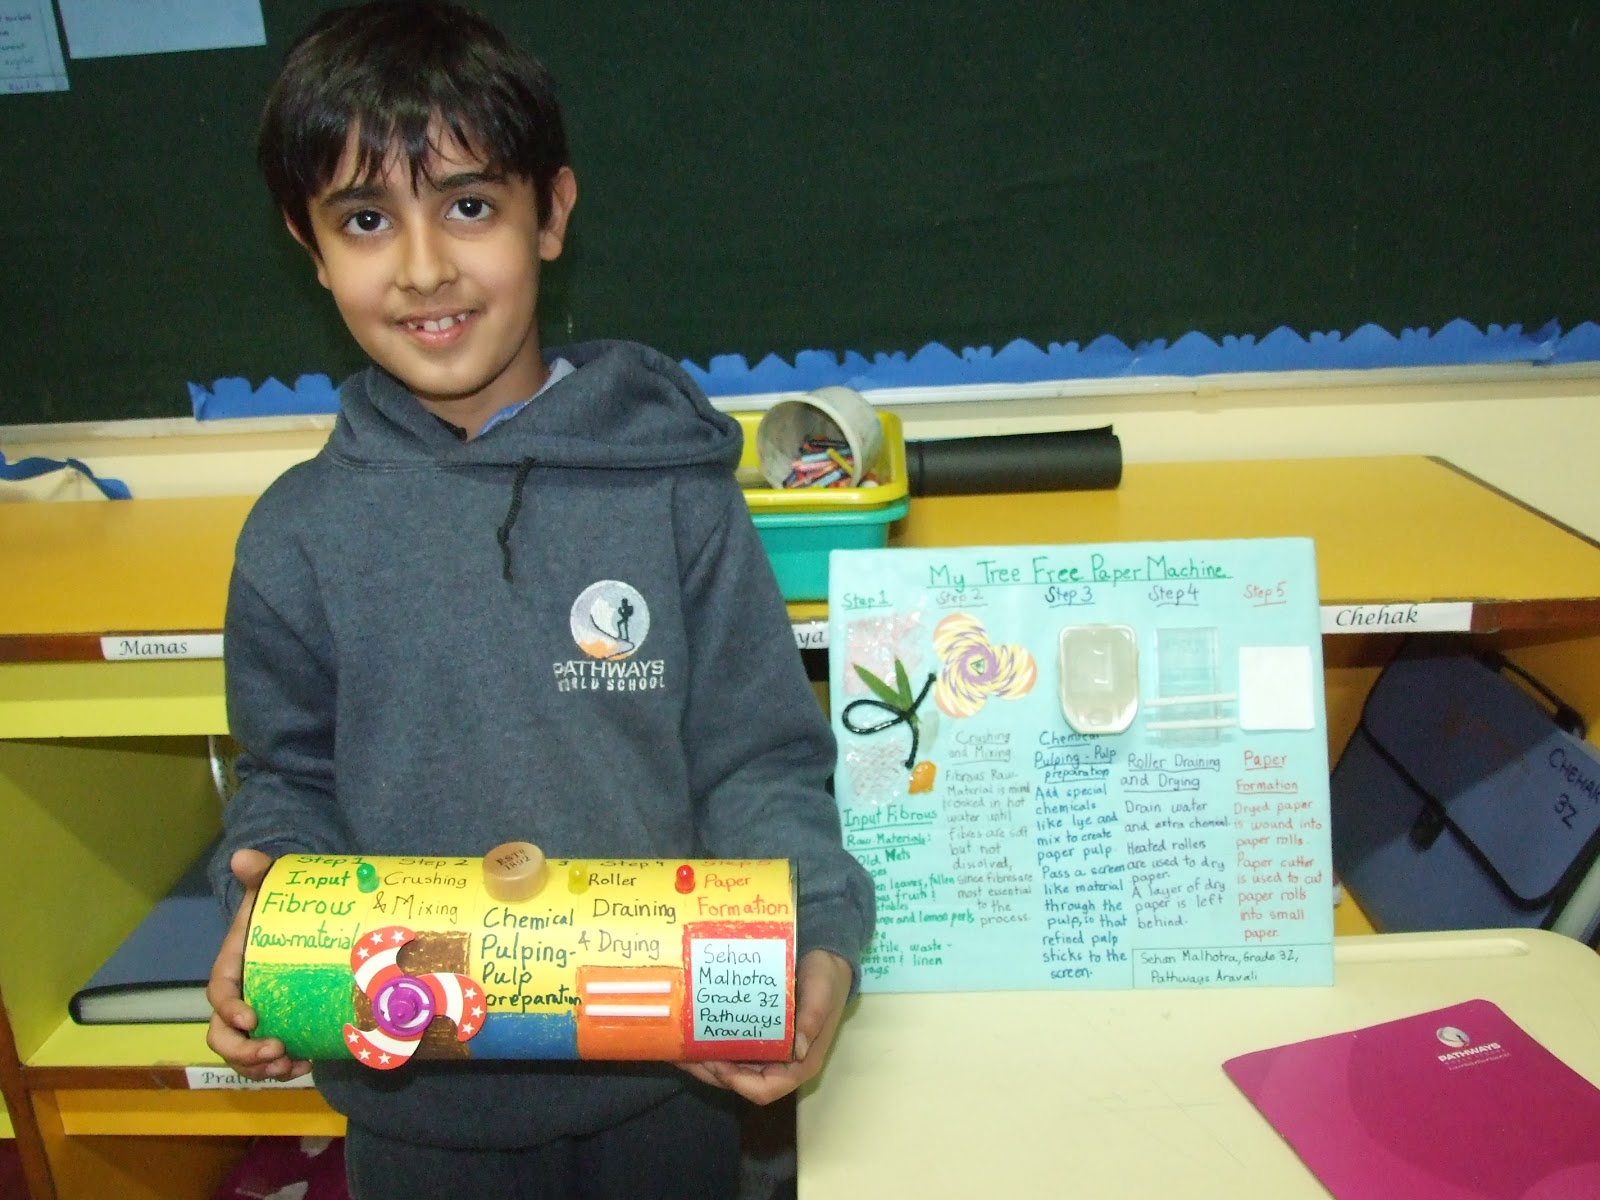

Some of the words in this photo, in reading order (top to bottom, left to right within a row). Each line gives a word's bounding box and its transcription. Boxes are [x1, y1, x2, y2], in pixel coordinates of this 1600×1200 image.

[929, 565, 966, 592] My
[977, 561, 1021, 584] Tree
[1033, 556, 1084, 583] Free
[1091, 554, 1142, 587] Paper
[1147, 555, 1229, 581] Machine
[843, 591, 875, 608] Step
[936, 590, 966, 606] Step
[971, 588, 984, 600] 2
[1045, 586, 1078, 605] Step
[1082, 586, 1093, 602] 3
[1148, 585, 1185, 605] Step
[1187, 583, 1200, 601] 4
[1243, 584, 1273, 604] Step
[1275, 581, 1287, 597] 5
[1336, 604, 1419, 627] Chehak
[119, 640, 188, 656] Manas
[553, 660, 665, 678] PATHWAYS
[606, 676, 665, 692] SCHOOL
[955, 730, 1011, 745] Crushing
[976, 745, 1012, 762] Mixing
[1035, 751, 1080, 770] Pulping
[1094, 745, 1117, 764] Pulp
[1128, 752, 1168, 769] Roller
[1174, 753, 1221, 772] Draining
[1244, 750, 1287, 769] Paper
[1120, 773, 1149, 786] and
[1158, 773, 1201, 792] Drying
[1235, 778, 1298, 791] Formation
[1035, 786, 1059, 801] Add
[1066, 783, 1108, 800] special
[1125, 800, 1162, 814] Drain
[1170, 797, 1208, 814] water
[1277, 800, 1313, 815] paper
[843, 807, 883, 831] Input
[886, 804, 938, 824] Fibrous
[946, 810, 980, 822] water
[1036, 817, 1063, 831] like
[1072, 814, 1093, 830] lye
[1097, 811, 1119, 825] and
[1124, 820, 1150, 833] and
[1154, 817, 1186, 829] extra
[1299, 817, 1323, 831] into
[846, 834, 872, 847] Raw
[1037, 834, 1061, 846] mix
[1066, 830, 1078, 843] to
[1081, 828, 1113, 842] create
[1236, 836, 1270, 851] paper
[949, 841, 972, 856] but
[980, 841, 1002, 855] not
[1037, 848, 1075, 867] paper
[1083, 844, 1112, 860] pulp
[1126, 838, 1167, 856] Heated
[297, 856, 348, 868] Step
[398, 857, 447, 868] Step
[453, 859, 470, 867] 2
[600, 860, 649, 870] Step
[857, 853, 882, 867] Old
[1126, 860, 1147, 871] are
[1151, 856, 1179, 869] used
[1184, 854, 1196, 868] to
[1200, 855, 1226, 873] dry
[1237, 850, 1273, 872] Paper
[1280, 855, 1315, 868] cutter
[286, 870, 351, 889] Input
[384, 871, 468, 889] Crushing
[588, 873, 638, 887] Roller
[1042, 866, 1071, 879] Pass
[1074, 868, 1087, 877] a
[1090, 864, 1126, 876] screen
[1252, 871, 1282, 884] used
[1287, 871, 1299, 884] to
[1304, 869, 1323, 885] cut
[704, 873, 752, 893] Paper
[1044, 882, 1070, 895] like
[1075, 878, 1124, 893] material
[1131, 886, 1143, 899] A
[1147, 884, 1183, 899] layer
[1186, 876, 1201, 893] of
[1204, 878, 1226, 893] dry
[957, 886, 982, 899] most
[1238, 891, 1274, 906] paper
[262, 891, 357, 916] Fibrous
[372, 890, 387, 914] &
[391, 894, 459, 925] Mixing
[592, 898, 677, 924] Draining
[697, 894, 789, 917] Formation
[991, 899, 1012, 913] the
[1045, 898, 1096, 914] through
[1102, 899, 1123, 912] the
[1135, 899, 1171, 916] paper
[1177, 899, 1187, 909] is
[1196, 893, 1224, 908] left
[483, 906, 575, 931] Chemical
[896, 911, 916, 925] and
[1100, 914, 1128, 928] that
[1269, 908, 1305, 921] small
[598, 929, 660, 961] Drying
[1042, 930, 1085, 946] refined
[1091, 930, 1119, 948] pulp
[703, 943, 761, 965] Sehan
[912, 953, 943, 967] linen
[1042, 947, 1083, 963] sticks
[1089, 949, 1101, 963] to
[1106, 948, 1128, 962] the
[1140, 952, 1177, 964] Sehan
[482, 961, 533, 996] Pulp
[699, 966, 777, 987] Malhotra
[1151, 970, 1211, 985] Pathways
[1216, 969, 1258, 982] Aravali
[696, 988, 752, 1004] Grade
[700, 1008, 782, 1028] Pathways
[704, 1025, 763, 1038] Aravali
[1437, 1042, 1502, 1063] PATHWAYS
